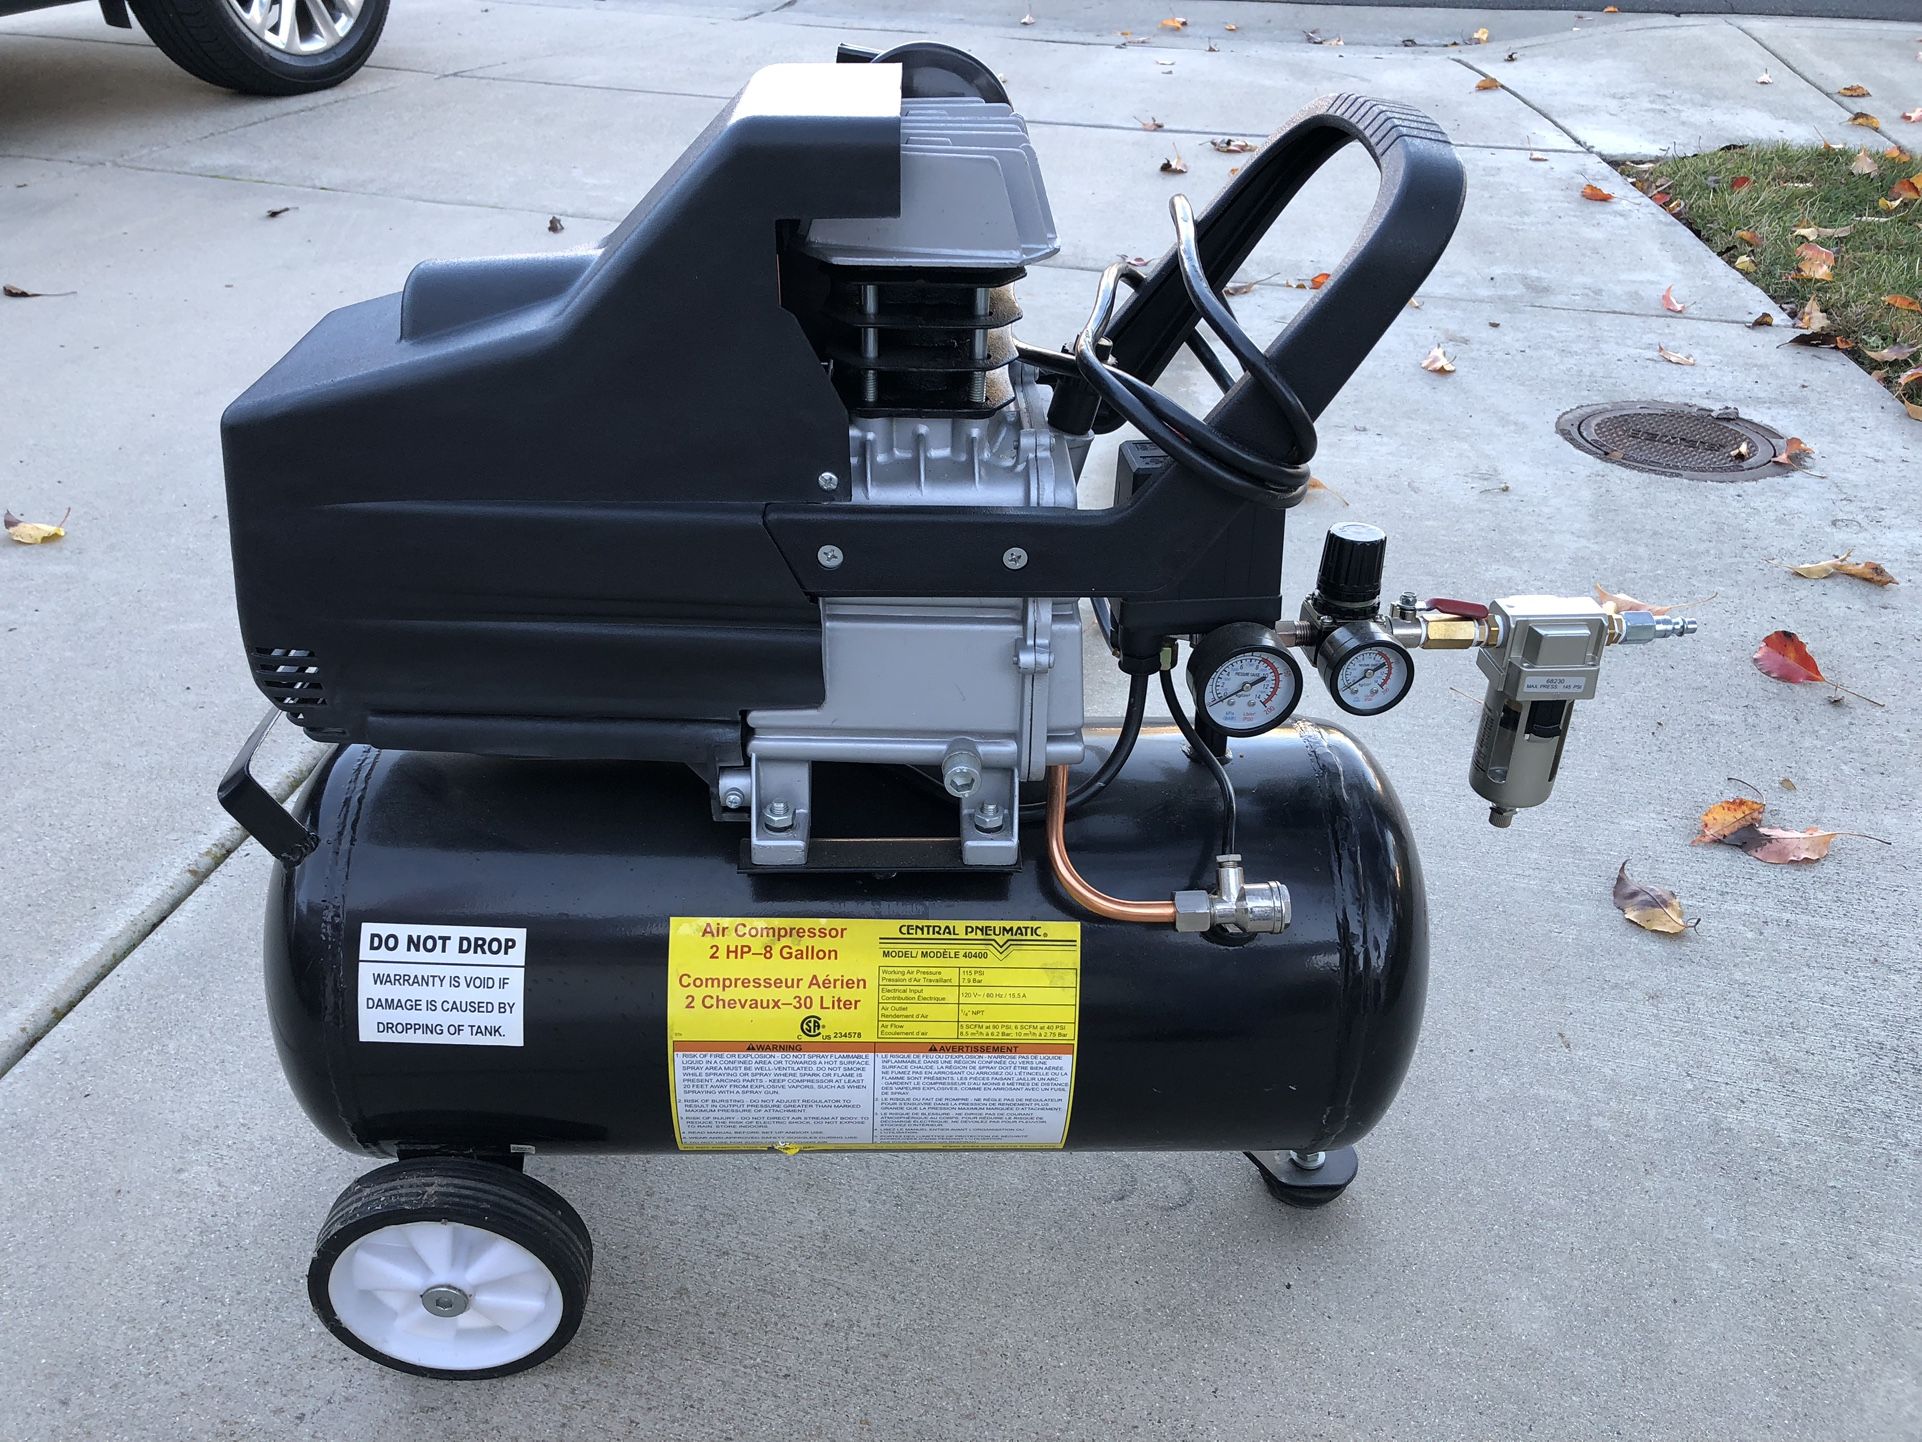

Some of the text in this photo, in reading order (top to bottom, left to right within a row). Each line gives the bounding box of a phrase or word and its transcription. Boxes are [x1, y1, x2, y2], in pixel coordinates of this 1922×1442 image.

[702, 923, 847, 941] Air Compressor
[899, 925, 959, 935] CENTRAL
[369, 933, 516, 955] DO NOT DROP
[709, 945, 719, 959] 2
[780, 945, 838, 960] Gallon
[883, 950, 918, 959] MODEL/
[921, 949, 960, 959] MODÈLE
[373, 973, 510, 989] WARRANTY IS VOID IF
[679, 974, 866, 991] Compresseur Aérien
[366, 998, 515, 1014] DAMAGE IS CAUSED BY
[685, 995, 695, 1009] 2
[820, 996, 861, 1010] Liter
[377, 1022, 505, 1037] DROPPING OF TANK.
